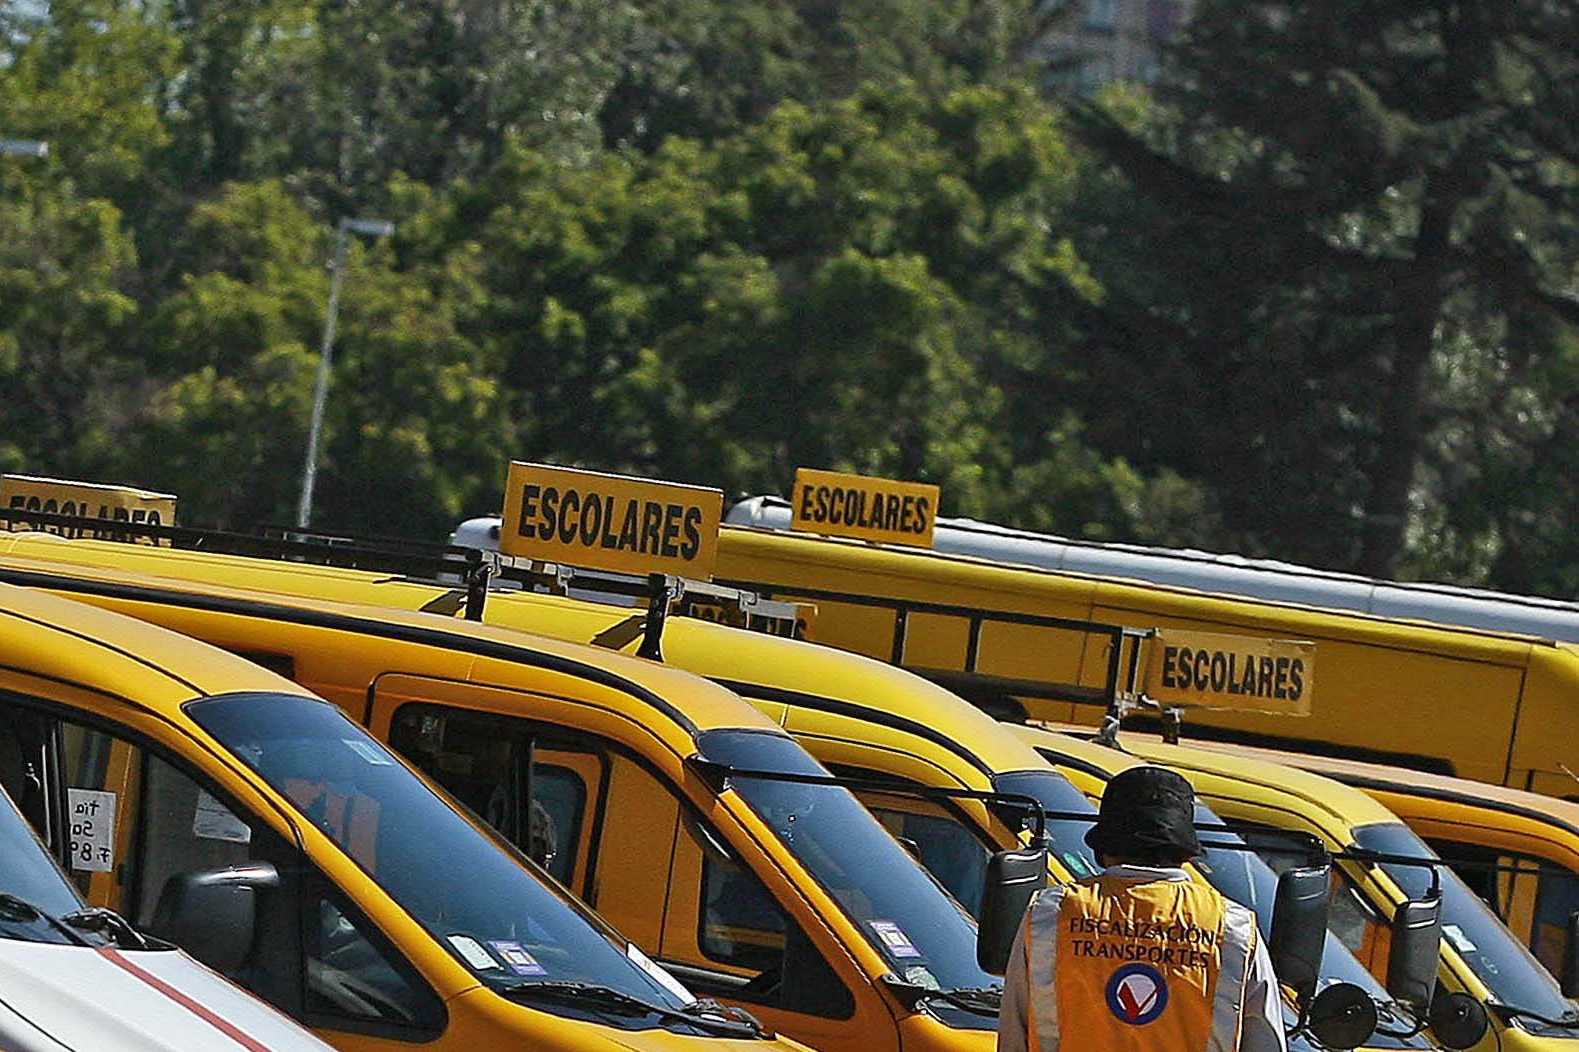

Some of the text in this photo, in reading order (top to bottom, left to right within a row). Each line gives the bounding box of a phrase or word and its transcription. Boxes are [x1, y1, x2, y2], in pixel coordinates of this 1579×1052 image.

[518, 484, 703, 562] ESCOLARES
[799, 484, 930, 535] ESCOLARES
[1162, 646, 1304, 701] ESCOLARES
[1070, 917, 1215, 946] FISCALIZACIÓN
[1072, 940, 1210, 968] TRANSPORTES
